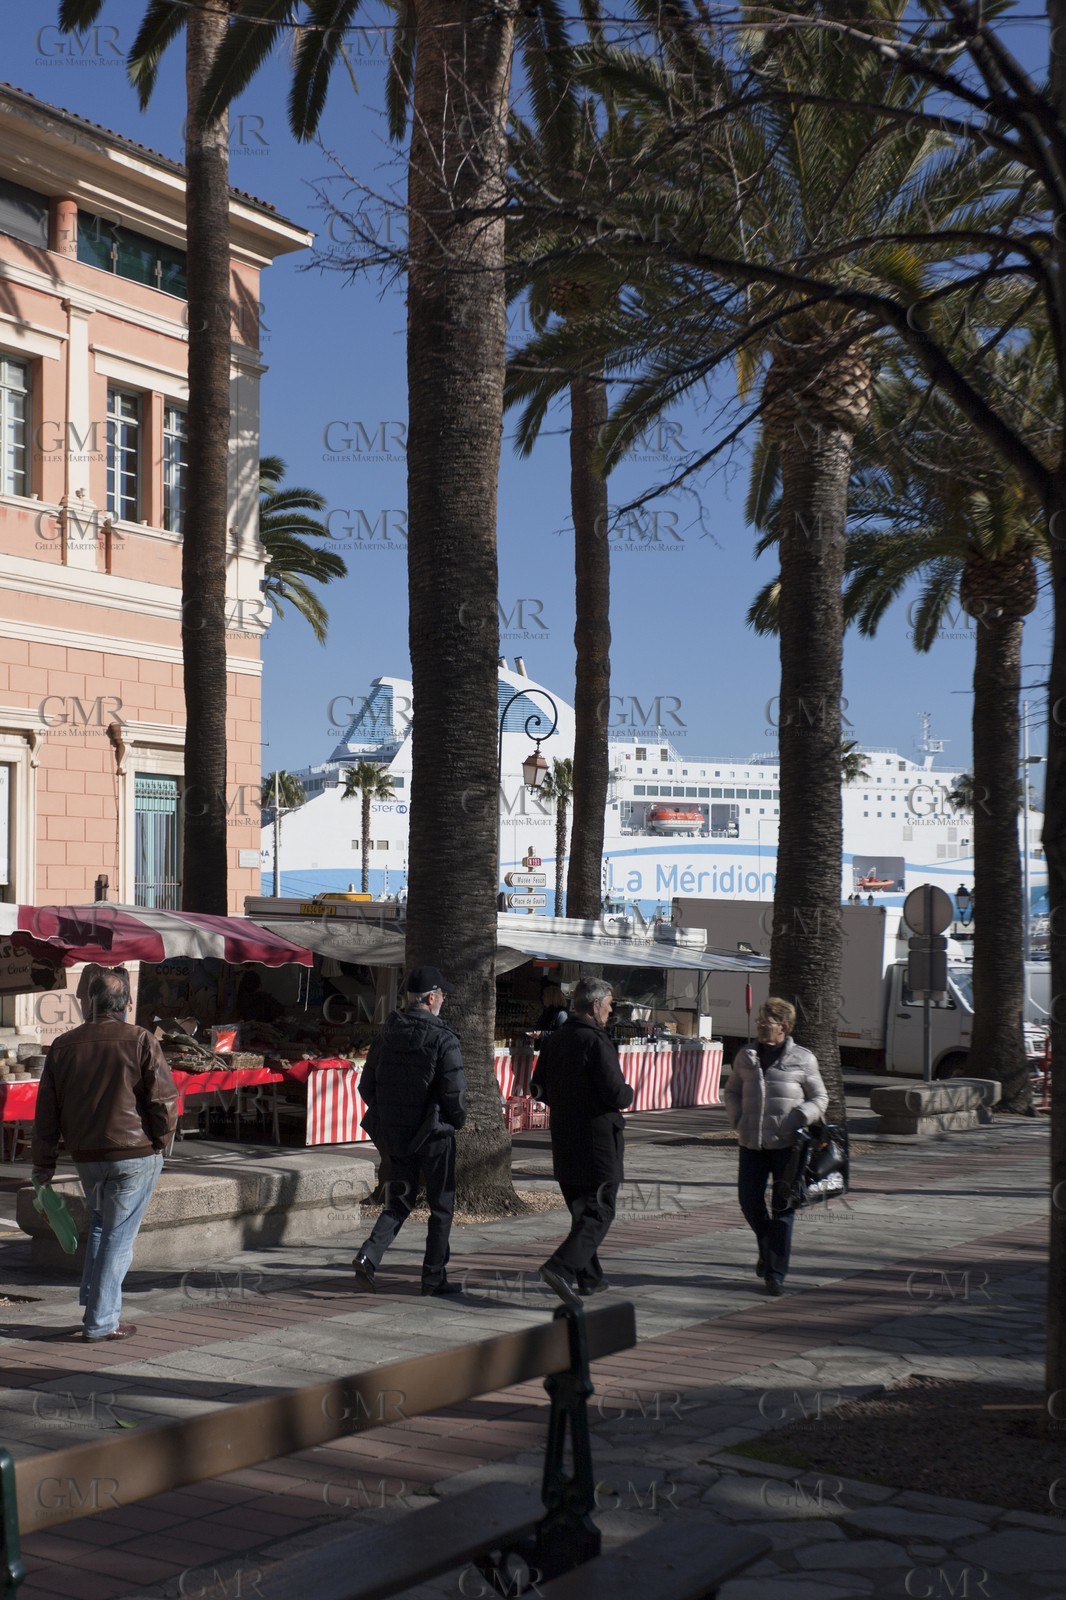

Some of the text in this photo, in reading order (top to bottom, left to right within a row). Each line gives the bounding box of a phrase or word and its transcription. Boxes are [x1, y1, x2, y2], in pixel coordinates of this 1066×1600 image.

[517, 876, 531, 884] Musée
[608, 863, 777, 893] La Méridion
[155, 965, 190, 976] corse
